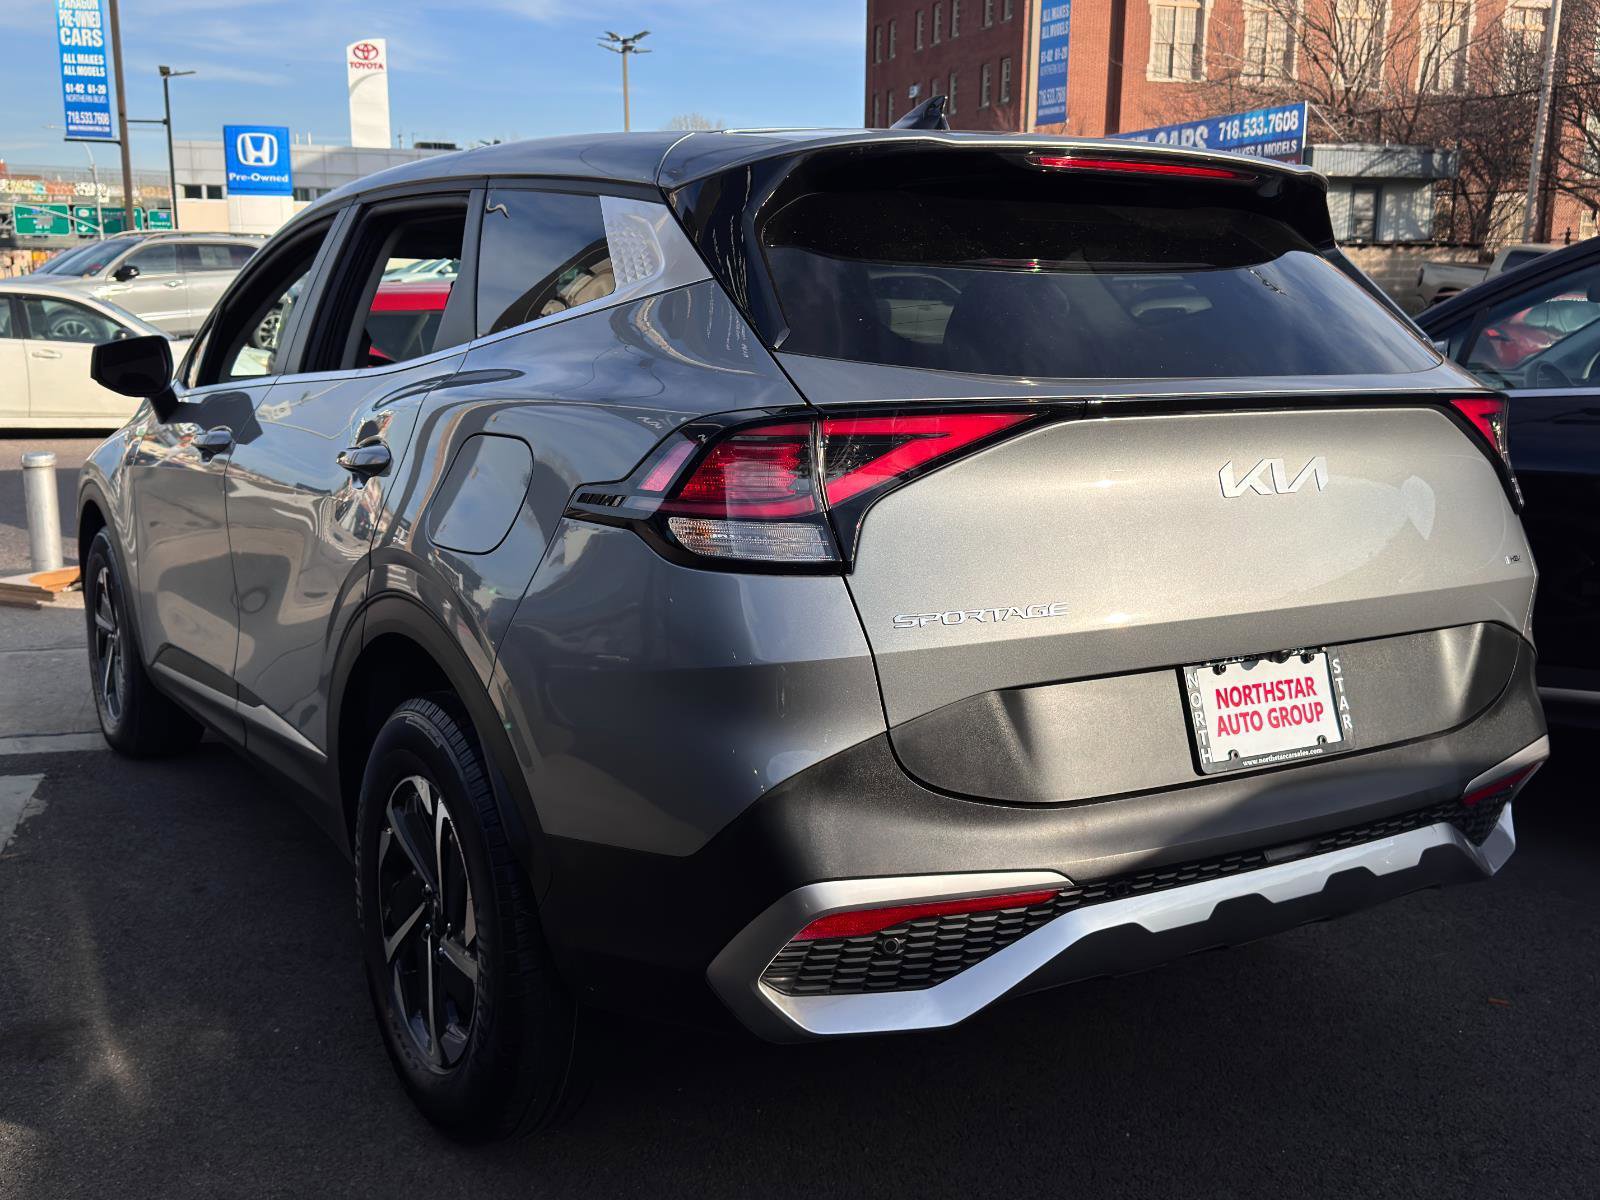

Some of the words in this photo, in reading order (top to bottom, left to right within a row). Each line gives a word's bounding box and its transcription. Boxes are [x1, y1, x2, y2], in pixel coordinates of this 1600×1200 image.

[60, 27, 103, 47] CARS
[63, 53, 77, 64] ALL
[77, 54, 104, 65] MAKES
[64, 65, 77, 76] ALL
[77, 66, 105, 77] MODELS
[349, 61, 384, 70] TOYOTA
[1218, 110, 1299, 142] 718.533.7608
[1263, 140, 1298, 157] MODELS
[228, 172, 289, 183] Pre-Owned
[1218, 456, 1329, 498] KIA
[892, 601, 1073, 629] SPORTAGE
[1215, 676, 1318, 710] NORTHSTAR
[1331, 658, 1353, 730] STAR
[1185, 672, 1214, 764] NORTH
[1217, 710, 1264, 738] AUTO
[1267, 701, 1324, 730] GROUP
[1242, 748, 1323, 767] www.northstarcarsales.com
